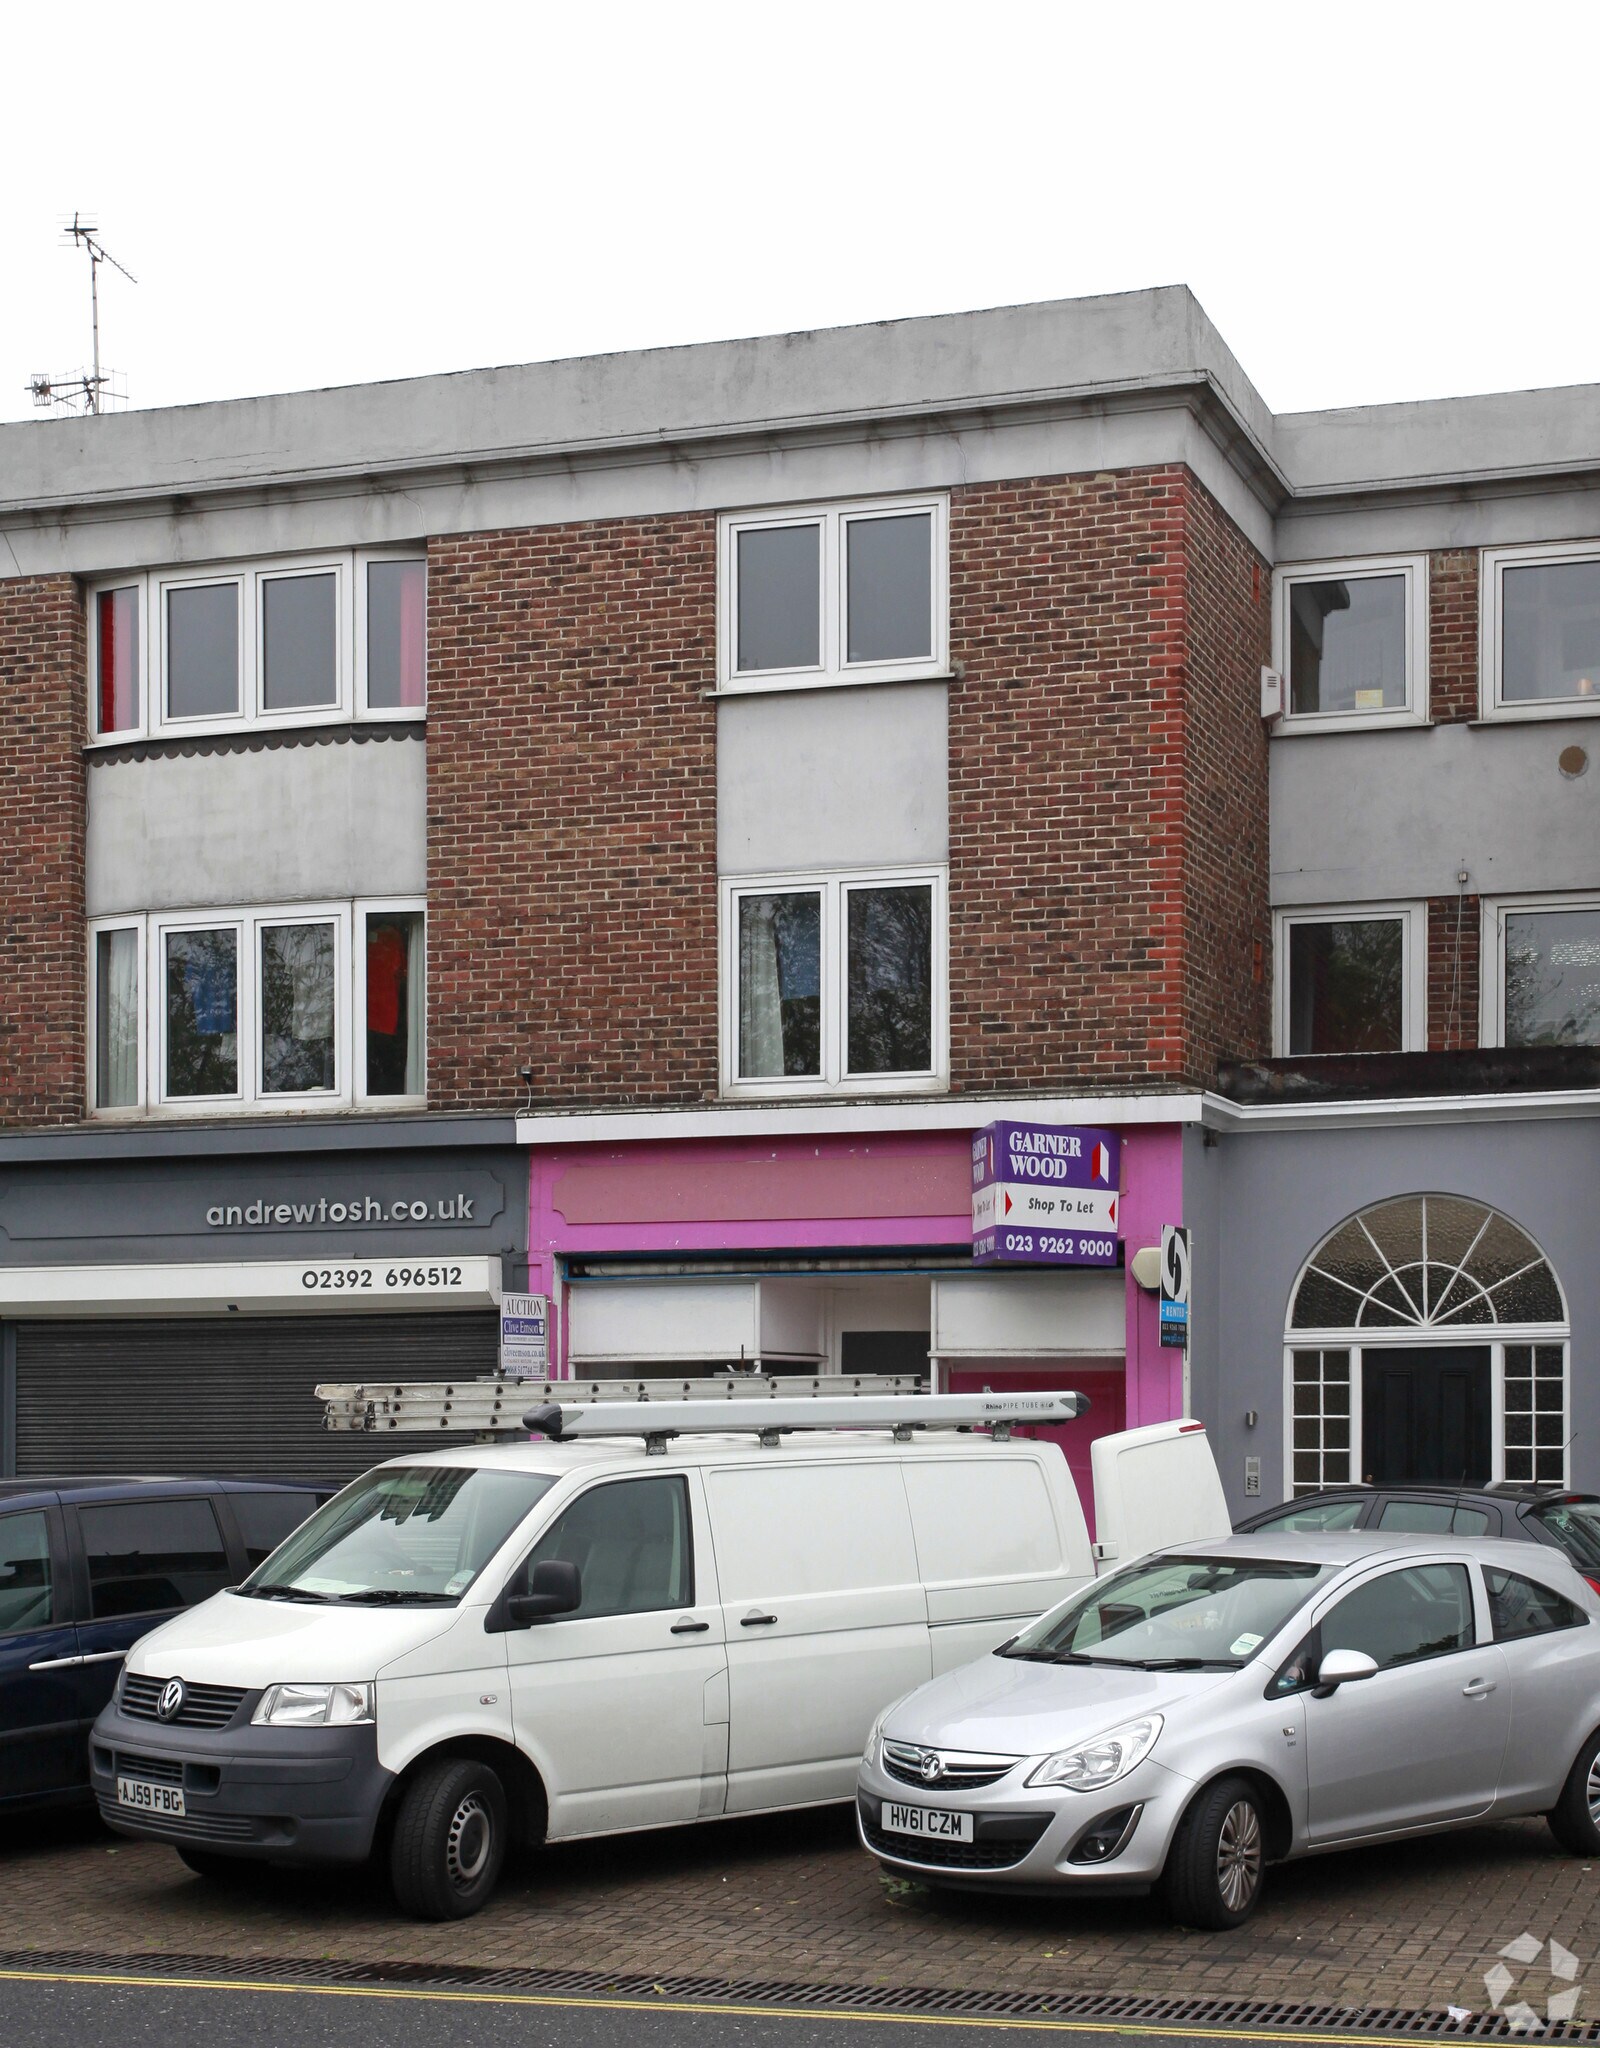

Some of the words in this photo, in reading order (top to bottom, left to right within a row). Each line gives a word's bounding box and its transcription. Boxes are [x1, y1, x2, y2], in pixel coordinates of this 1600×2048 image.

[1009, 1131, 1082, 1157] GARNER
[1009, 1154, 1067, 1179] WOOD
[206, 1194, 474, 1226] andrewtosh.co.uk
[1028, 1197, 1055, 1214] Shop
[1060, 1199, 1073, 1212] To
[1076, 1200, 1094, 1213] Let
[1005, 1234, 1033, 1252] 023
[1039, 1236, 1073, 1254] 9262
[1079, 1239, 1113, 1257] 9000
[302, 1269, 372, 1289] 02392
[385, 1267, 462, 1287] 696512
[506, 1299, 542, 1316] AUCTION
[504, 1320, 519, 1334] Clive
[520, 1320, 539, 1334] Emson
[1022, 1401, 1039, 1409] TUBE
[122, 1782, 151, 1806] AJ59
[154, 1786, 181, 1811] FBG
[890, 1805, 923, 1831] HV61
[927, 1812, 962, 1836] CZM
